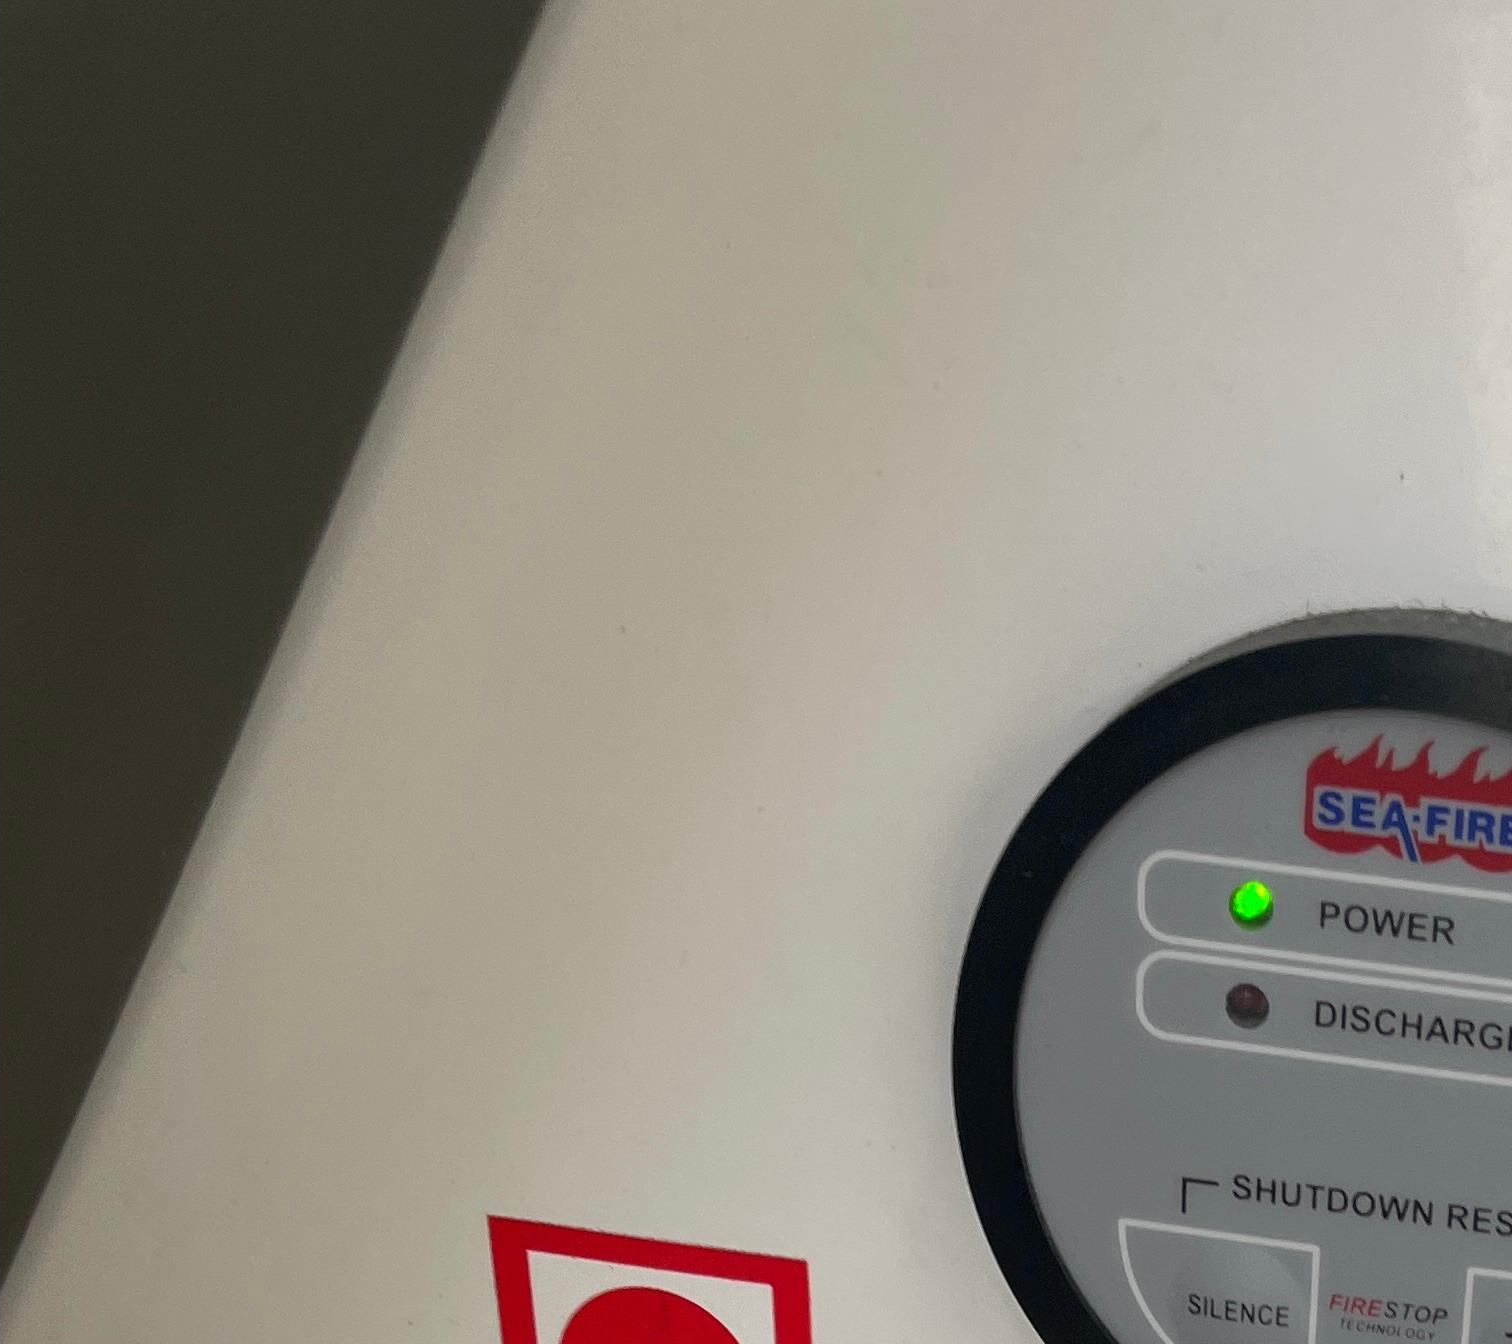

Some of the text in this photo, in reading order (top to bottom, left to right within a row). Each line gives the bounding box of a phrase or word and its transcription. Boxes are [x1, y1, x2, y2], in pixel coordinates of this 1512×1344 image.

[1319, 900, 1455, 945] POWER
[1231, 1173, 1434, 1227] SHUTDOWN
[1187, 1292, 1290, 1328] SILENCE
[1328, 1294, 1449, 1325] FIRESTOP
[1339, 1317, 1437, 1341] TECHNOLOGY
